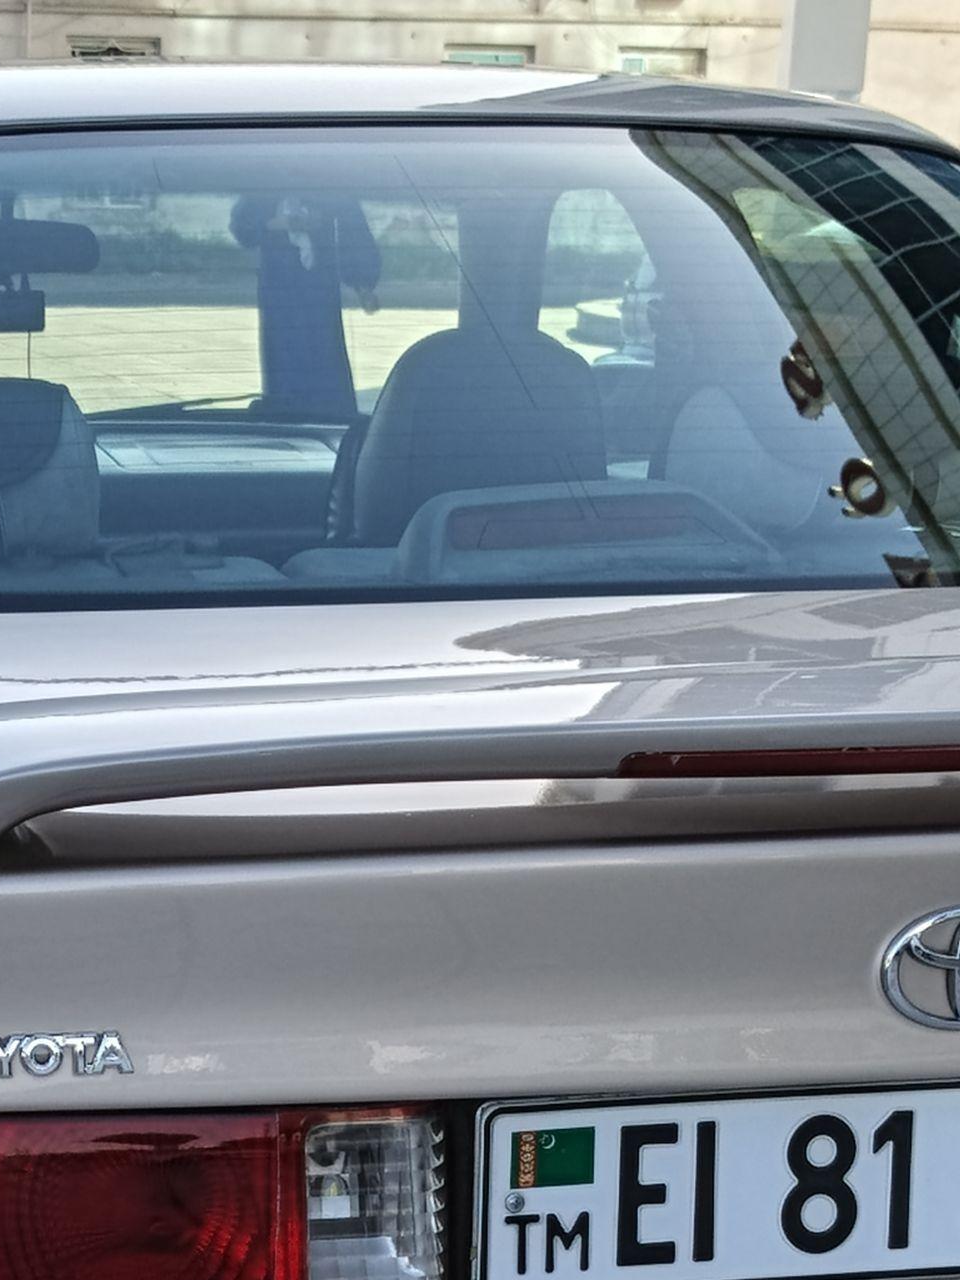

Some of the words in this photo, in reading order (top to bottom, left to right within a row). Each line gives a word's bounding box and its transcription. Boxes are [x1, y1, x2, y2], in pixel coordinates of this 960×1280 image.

[504, 1211, 590, 1275] TM
[616, 1121, 717, 1267] EI
[780, 1110, 914, 1254] 81
